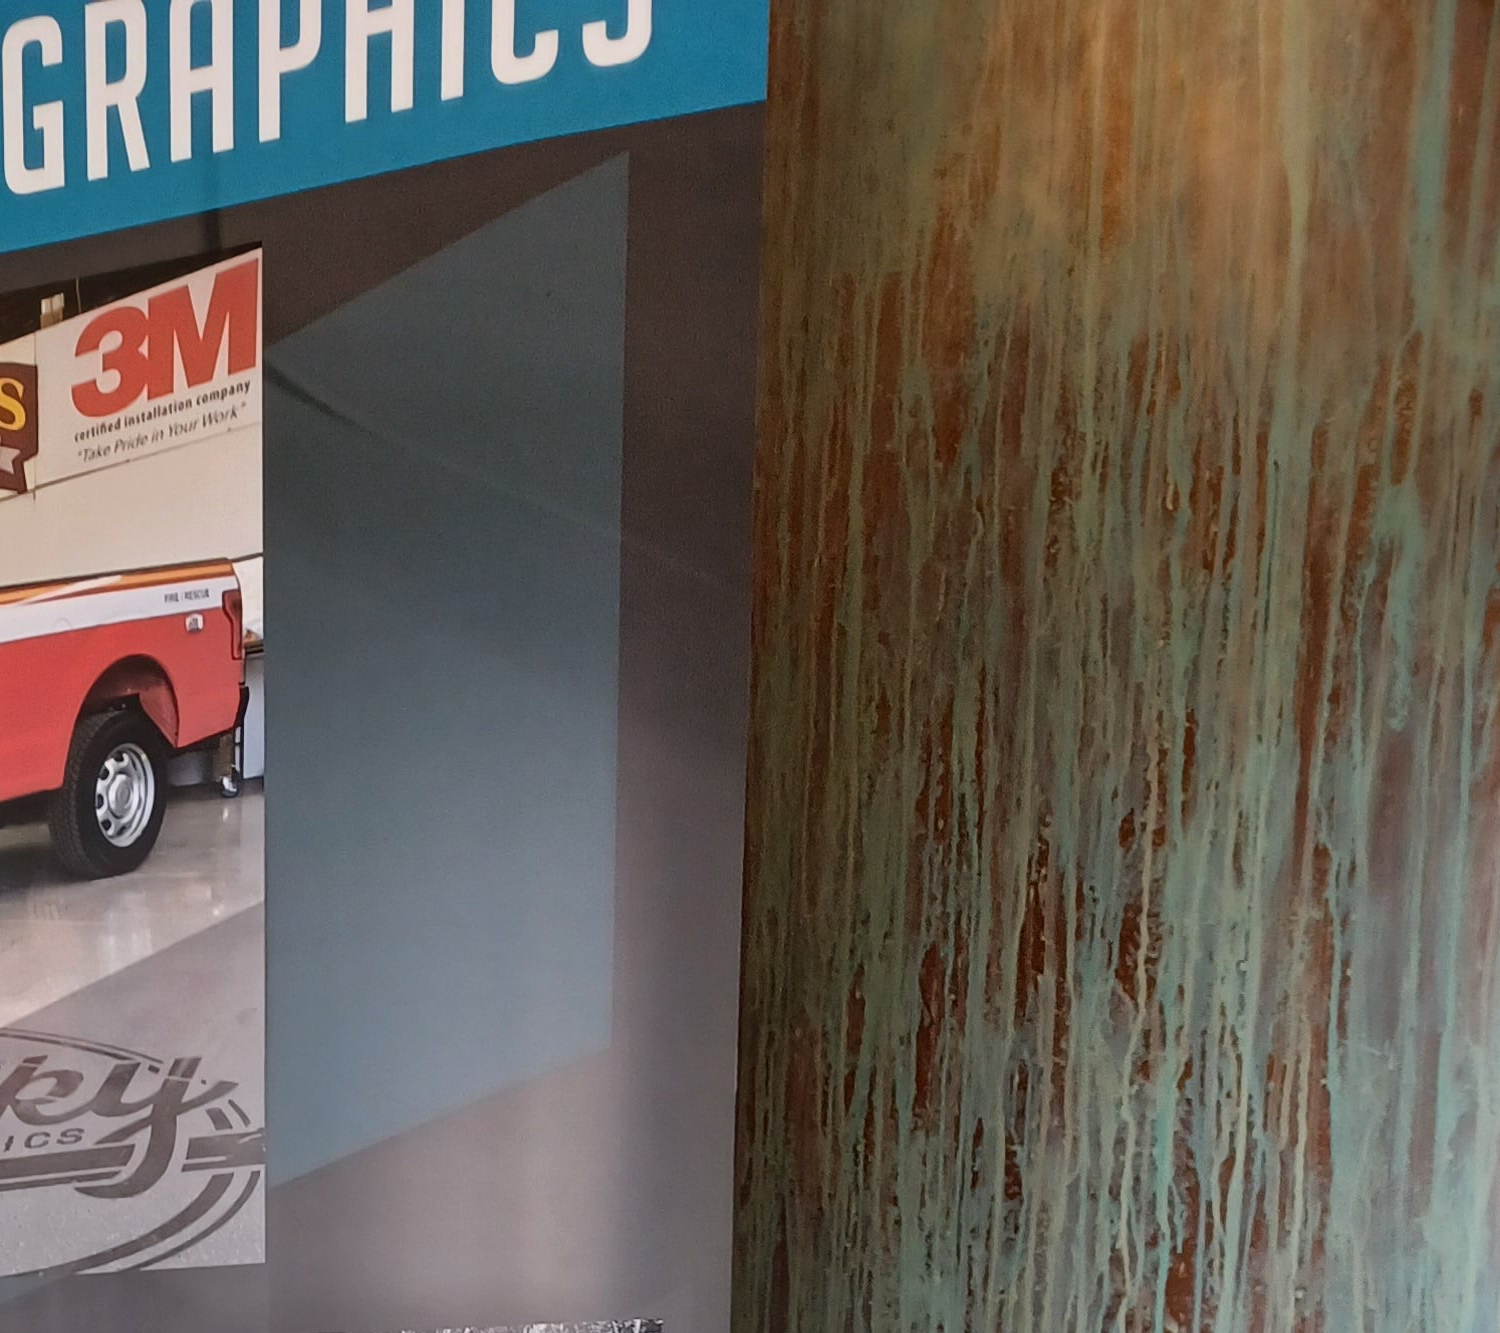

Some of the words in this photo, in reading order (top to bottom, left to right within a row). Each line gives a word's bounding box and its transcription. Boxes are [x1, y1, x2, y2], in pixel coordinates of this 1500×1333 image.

[71, 257, 259, 418] 3M
[74, 417, 121, 443] certified
[124, 399, 192, 427] installation
[196, 380, 251, 406] company
[114, 434, 149, 454] Pride
[151, 429, 164, 443] in
[168, 420, 197, 439] Your
